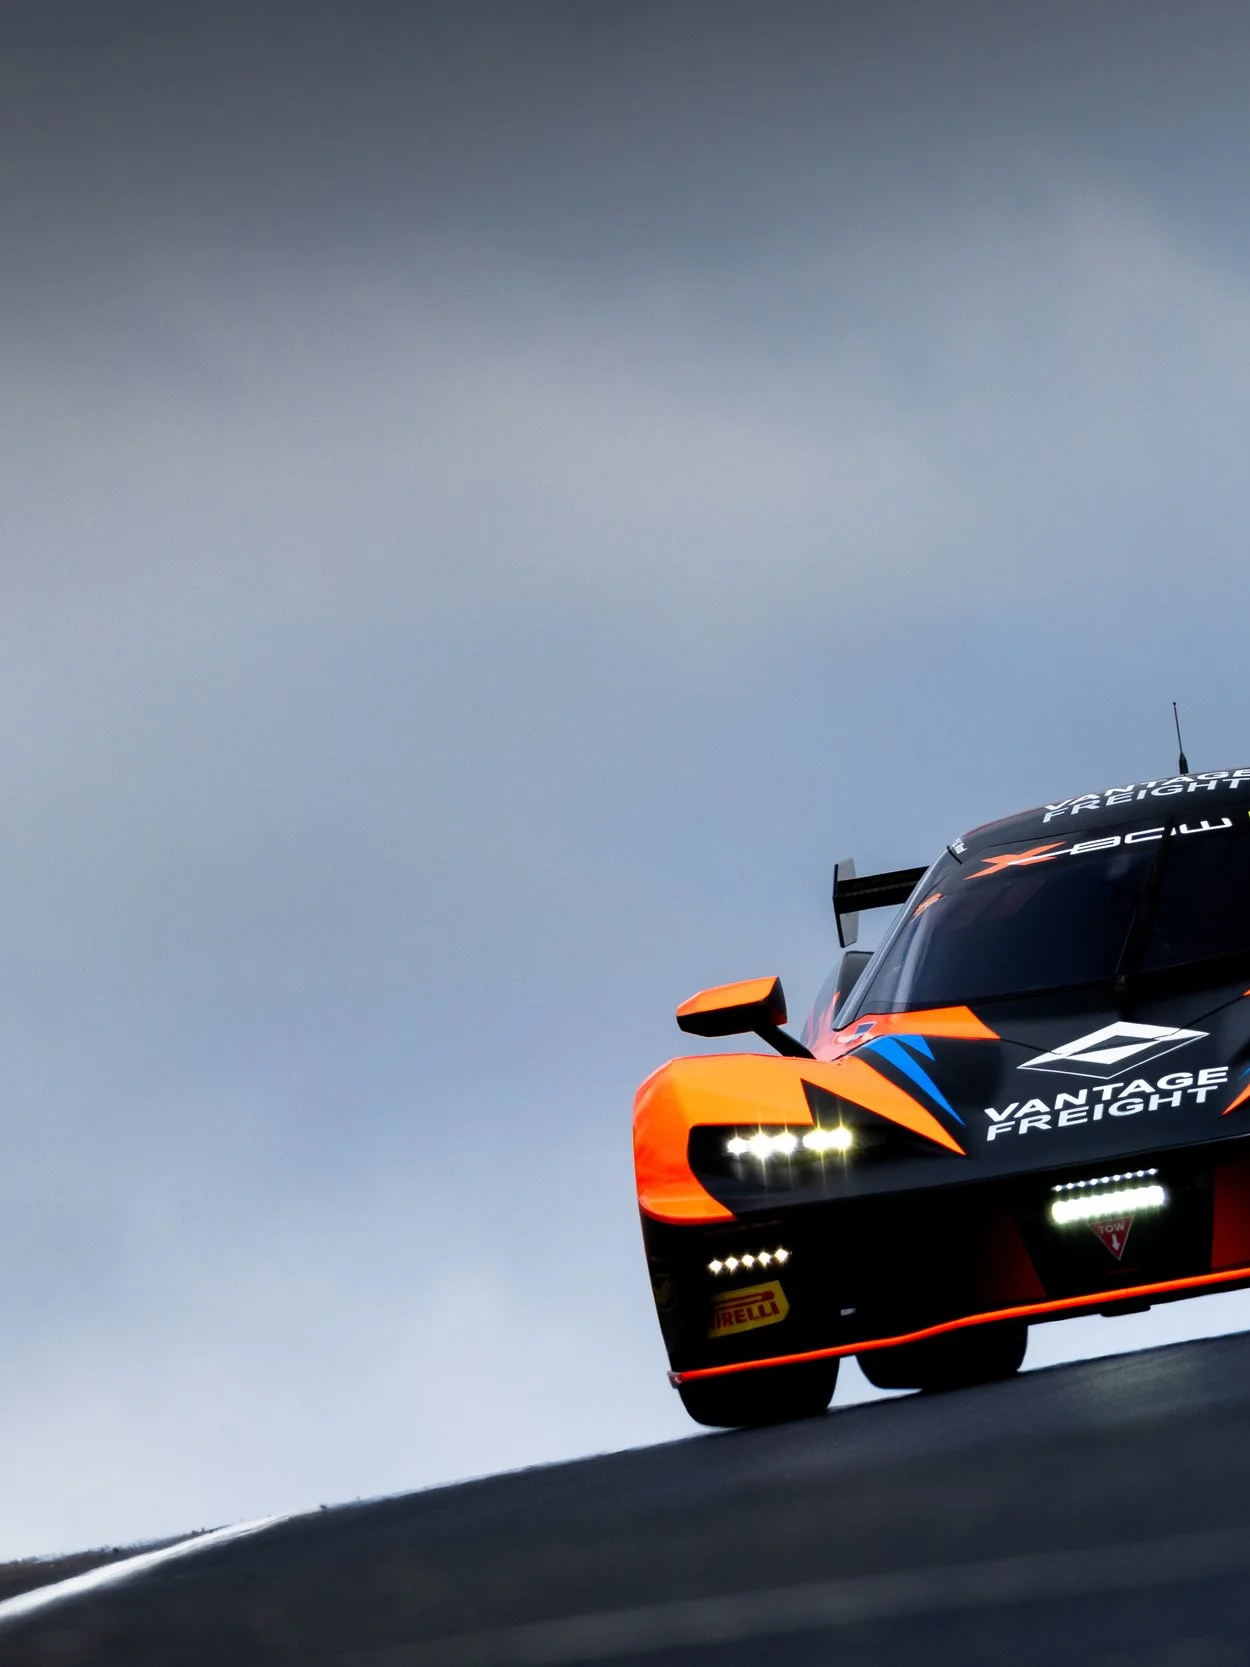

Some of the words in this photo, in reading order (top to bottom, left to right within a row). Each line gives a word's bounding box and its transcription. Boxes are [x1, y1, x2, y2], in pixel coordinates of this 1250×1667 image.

[1042, 777, 1250, 823] FREIGHT
[984, 1066, 1229, 1122] VANTAGE
[986, 1085, 1218, 1142] FREIGHT
[1097, 1222, 1125, 1234] TOW
